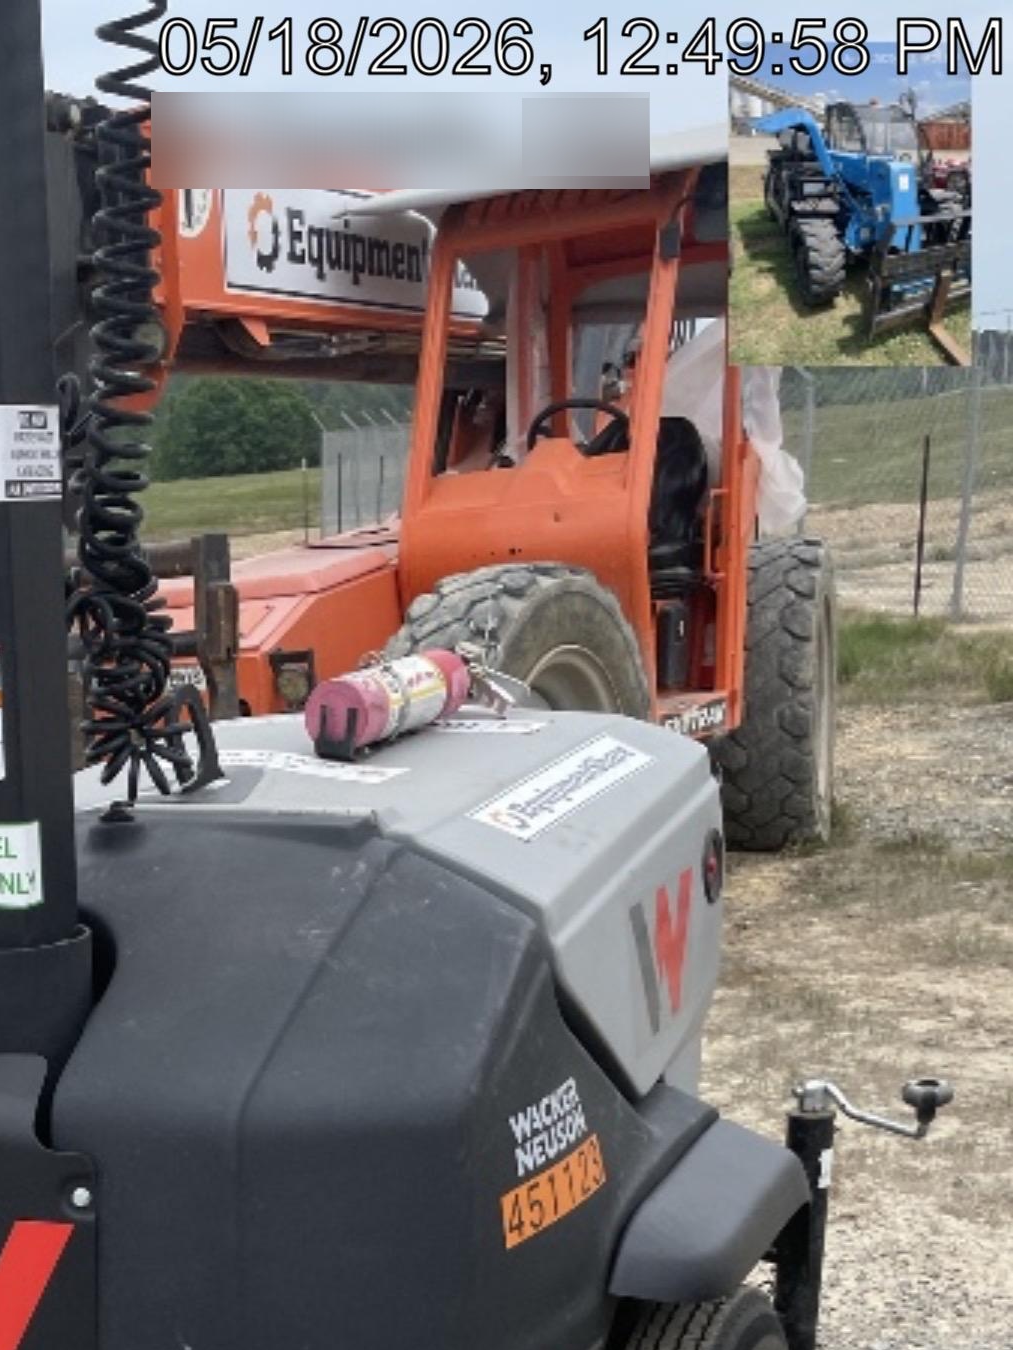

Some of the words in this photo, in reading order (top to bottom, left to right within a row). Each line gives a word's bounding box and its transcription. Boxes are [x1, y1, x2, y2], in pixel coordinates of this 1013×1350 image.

[508, 1076, 580, 1145] WACKER
[514, 1103, 587, 1177] NEUSON
[507, 1138, 603, 1237] 451123
